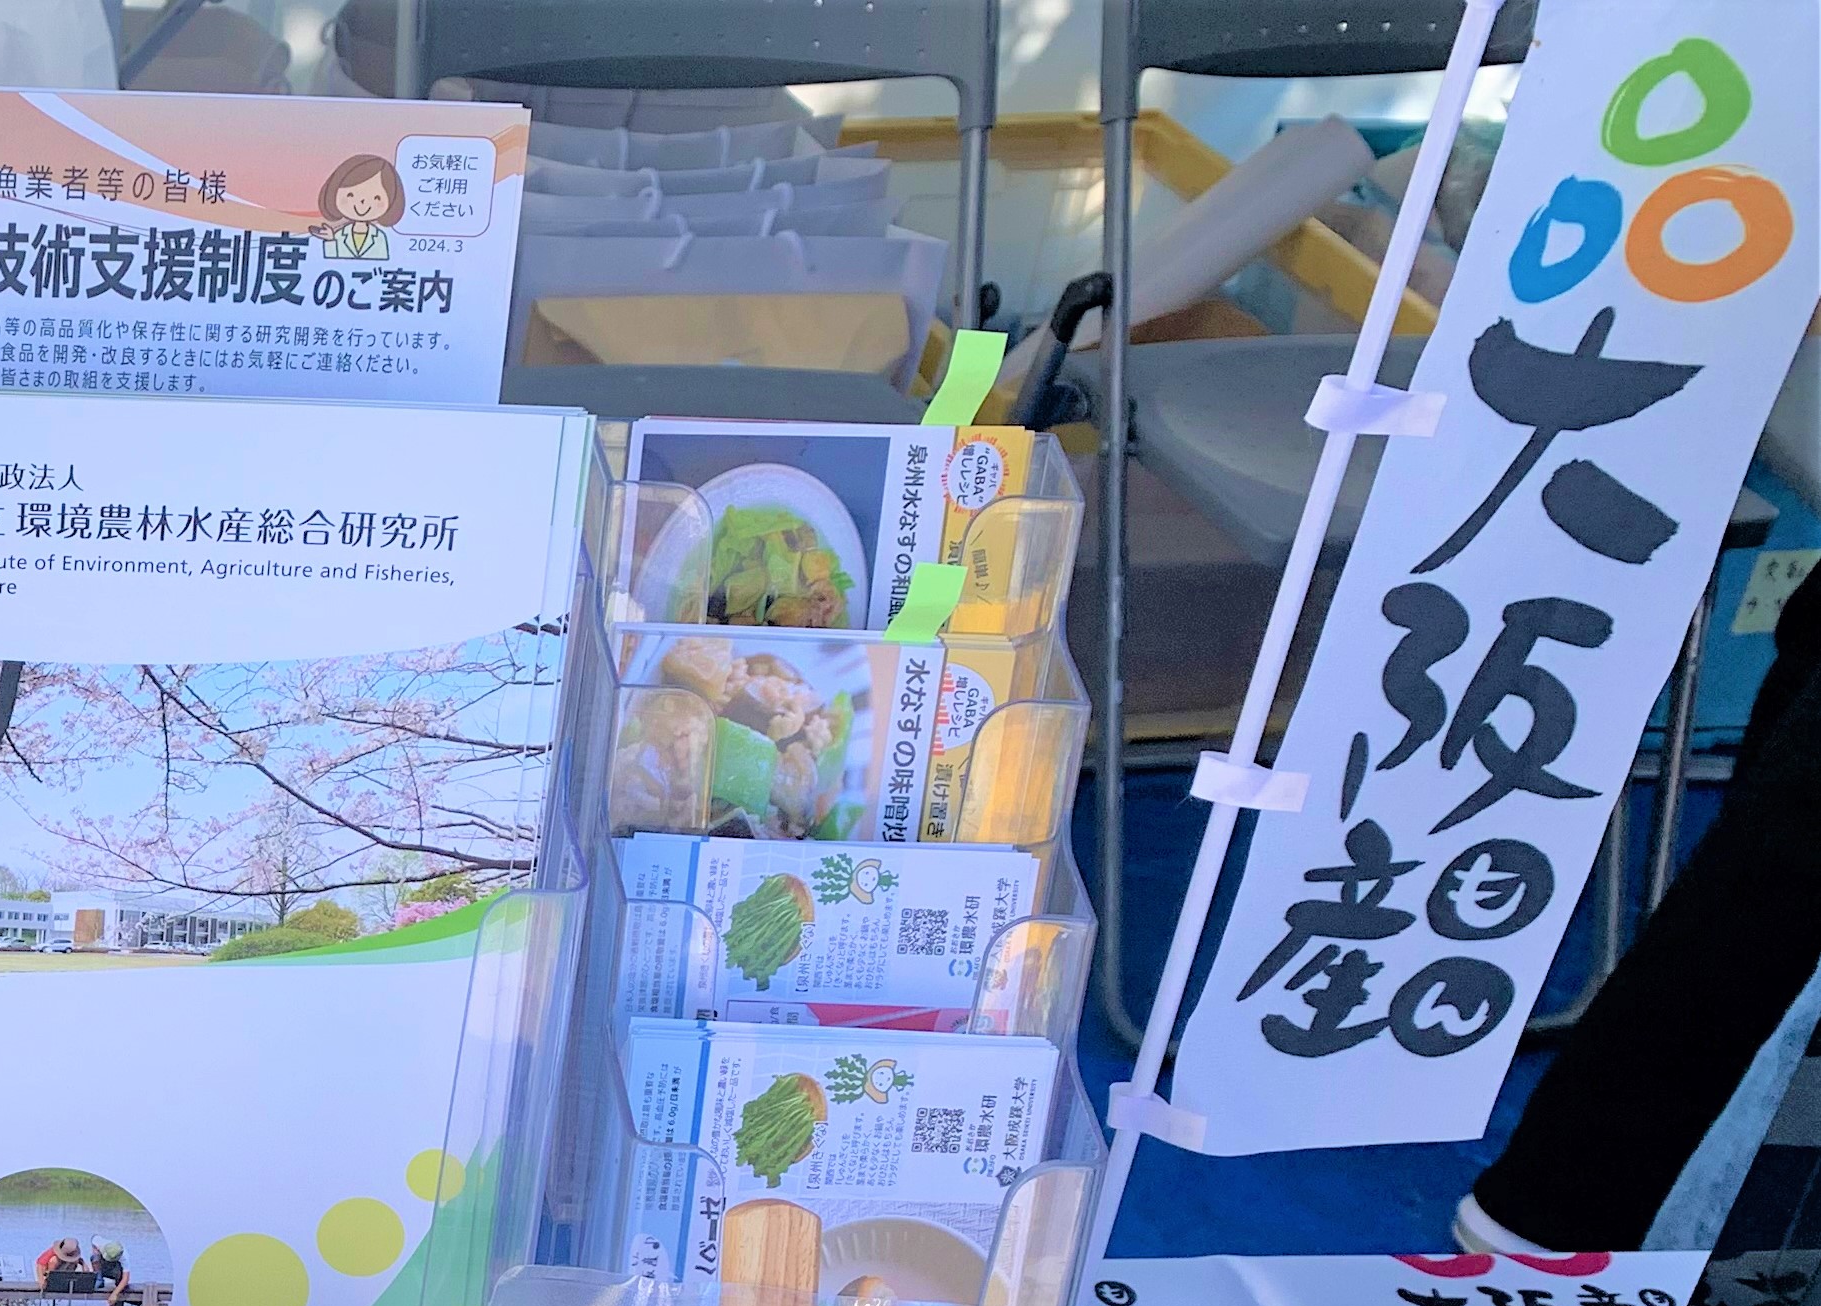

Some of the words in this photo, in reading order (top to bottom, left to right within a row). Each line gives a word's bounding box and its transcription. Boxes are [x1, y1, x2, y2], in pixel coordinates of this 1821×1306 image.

[412, 153, 478, 172] お気軽に
[417, 177, 469, 196] ご利用
[409, 202, 475, 219] ください
[956, 443, 975, 506] 増しレシピ
[16, 501, 461, 553] 環境農林水産総合研究所
[34, 553, 56, 571] of
[62, 555, 193, 578] Environment,
[200, 559, 314, 581] Agriculture
[320, 561, 358, 580] and
[364, 563, 456, 587] Fisheries,
[948, 675, 970, 739] 増しレシピ
[963, 688, 980, 729] GABA
[926, 762, 955, 839] 漬け置き
[959, 895, 982, 956] 環農水研
[974, 1094, 999, 1153] 環農水研
[1003, 1075, 1030, 1161] 大阪成蹊大学
